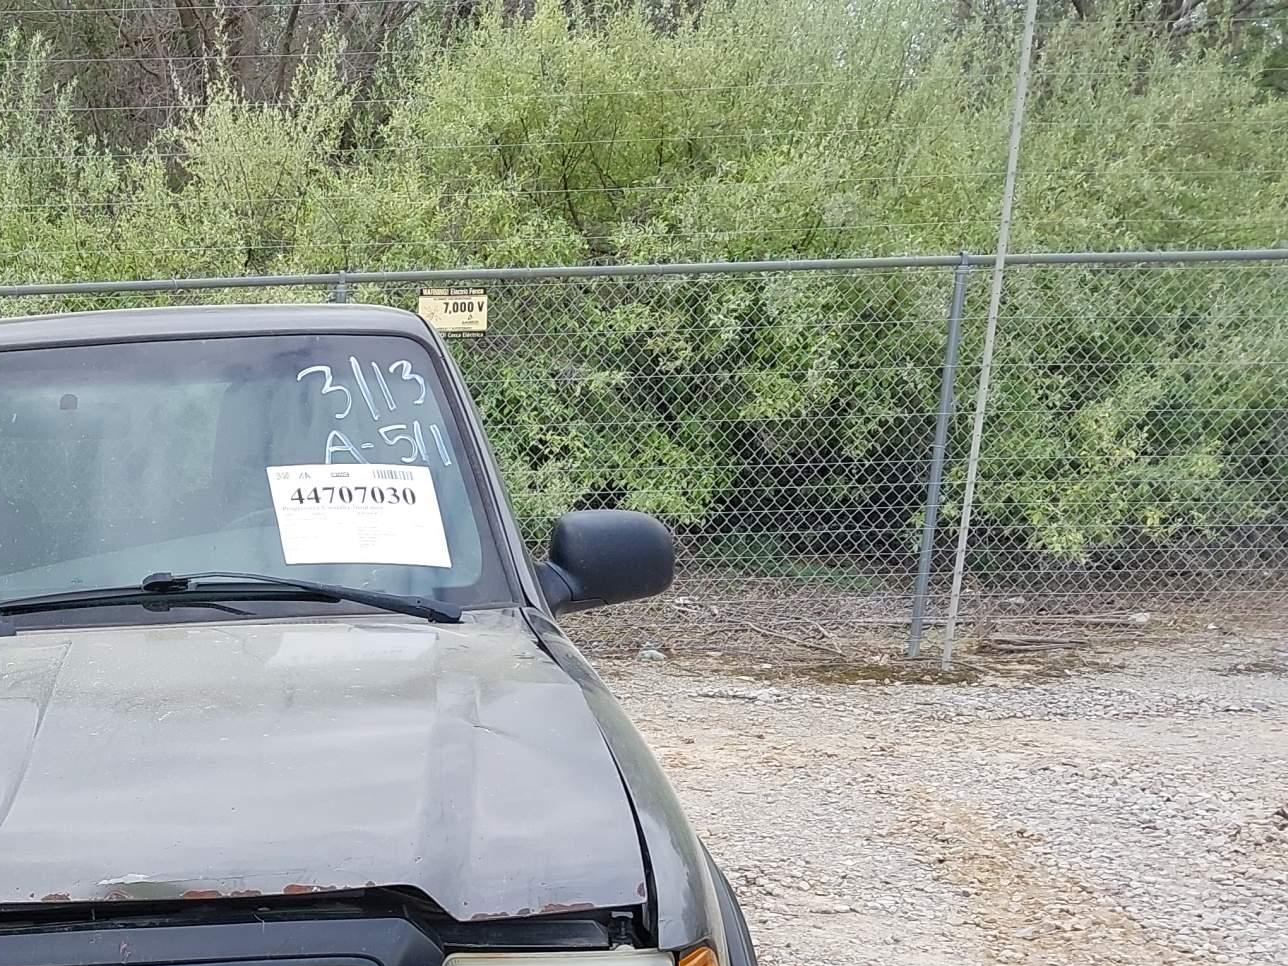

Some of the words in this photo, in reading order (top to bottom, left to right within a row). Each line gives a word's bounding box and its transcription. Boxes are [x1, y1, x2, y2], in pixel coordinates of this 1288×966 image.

[443, 302, 474, 314] 7,000
[477, 301, 484, 312] V
[290, 486, 416, 505] 44707030
